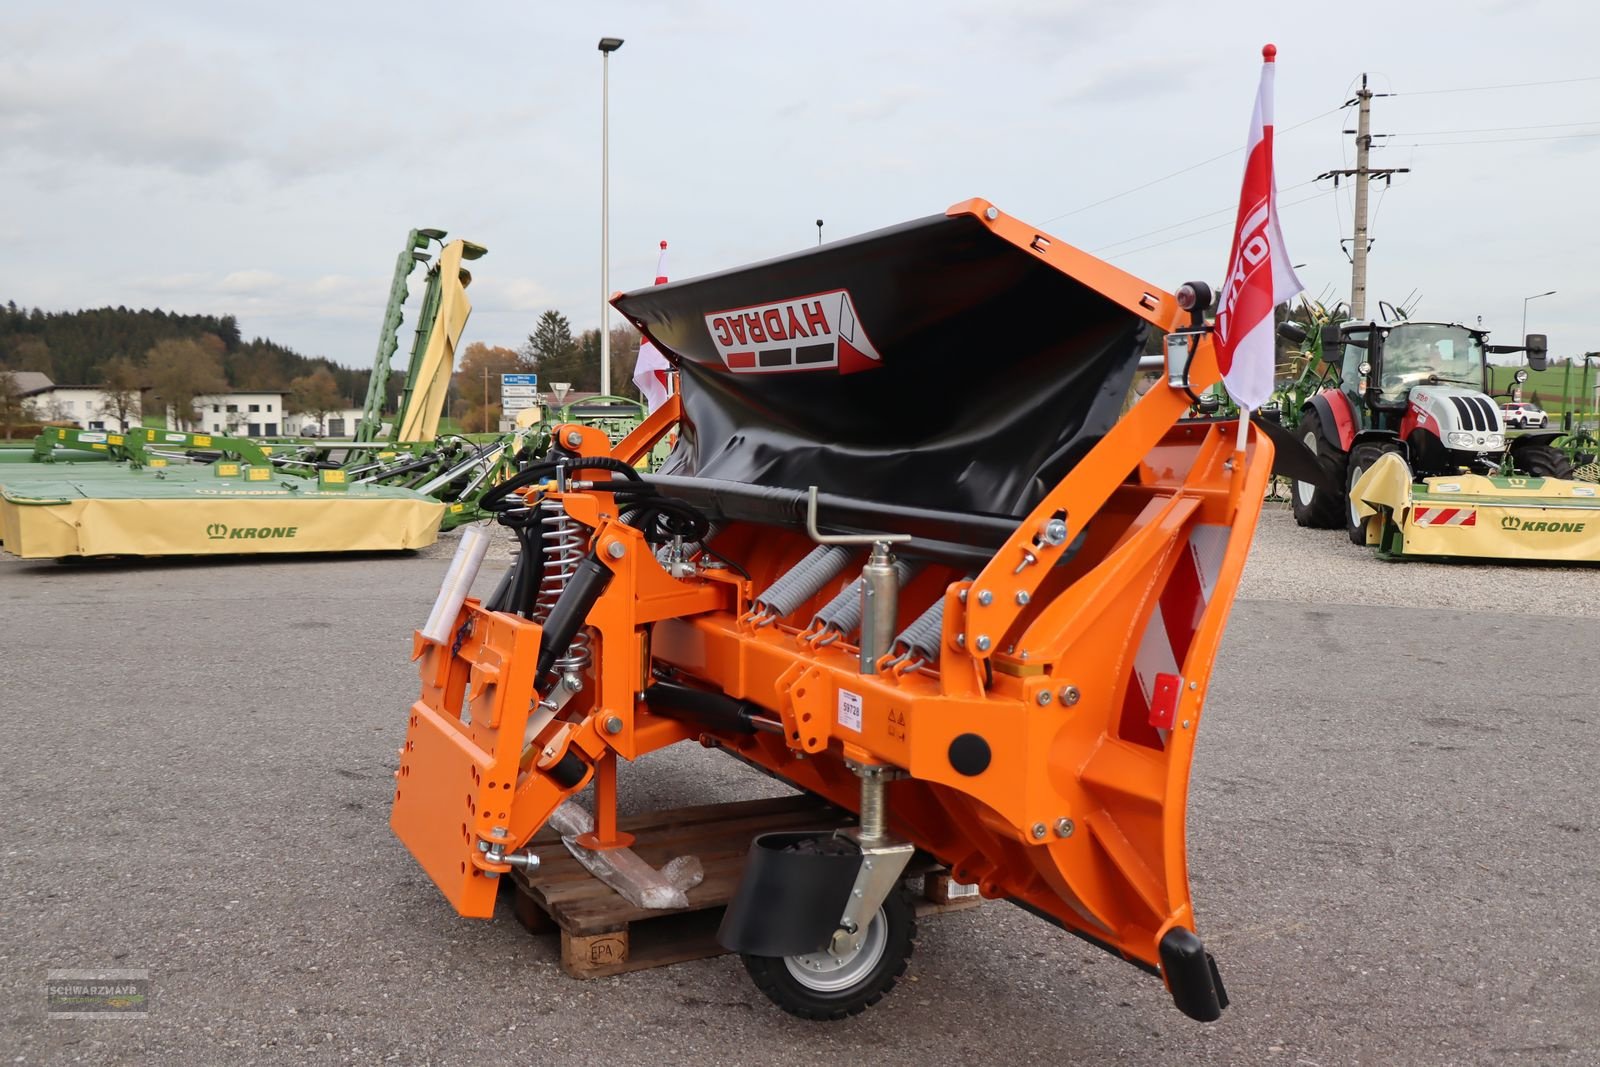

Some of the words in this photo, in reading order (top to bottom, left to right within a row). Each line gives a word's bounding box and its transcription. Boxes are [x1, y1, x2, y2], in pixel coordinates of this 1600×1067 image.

[713, 301, 831, 346] HYDRAC
[229, 527, 298, 539] KRONE
[1521, 521, 1586, 532] KRONE
[591, 944, 613, 960] EPA
